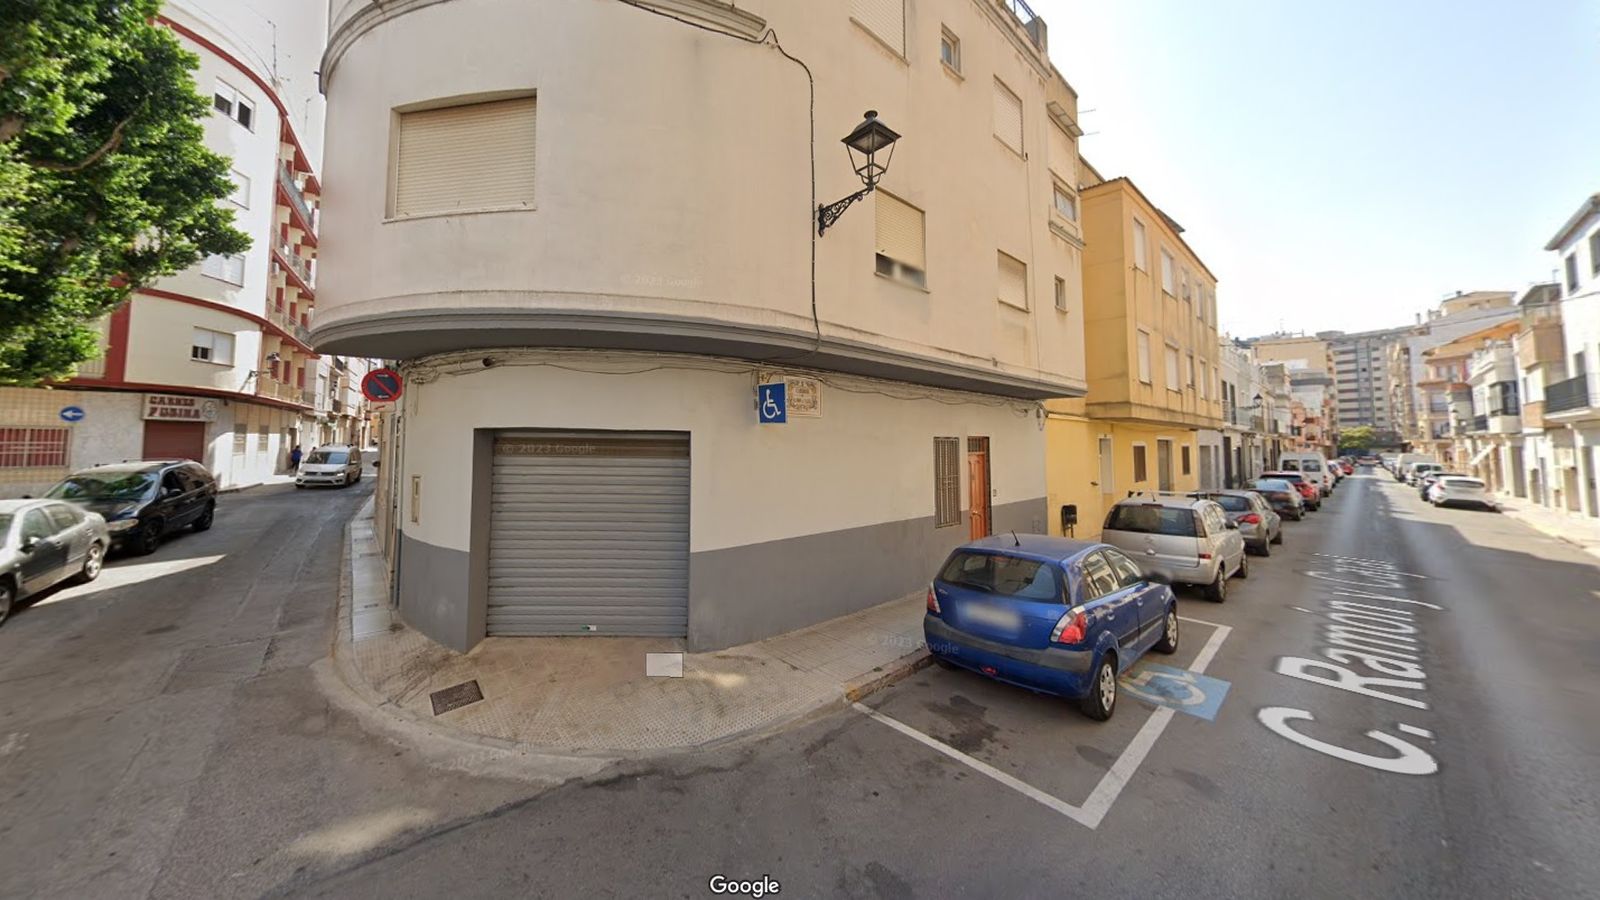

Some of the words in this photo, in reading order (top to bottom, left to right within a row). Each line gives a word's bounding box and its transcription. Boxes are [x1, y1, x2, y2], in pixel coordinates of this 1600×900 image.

[1306, 552, 1428, 589] Cajal
[1332, 586, 1444, 611] y
[1277, 600, 1431, 710] Ramón
[1257, 706, 1439, 775] C.
